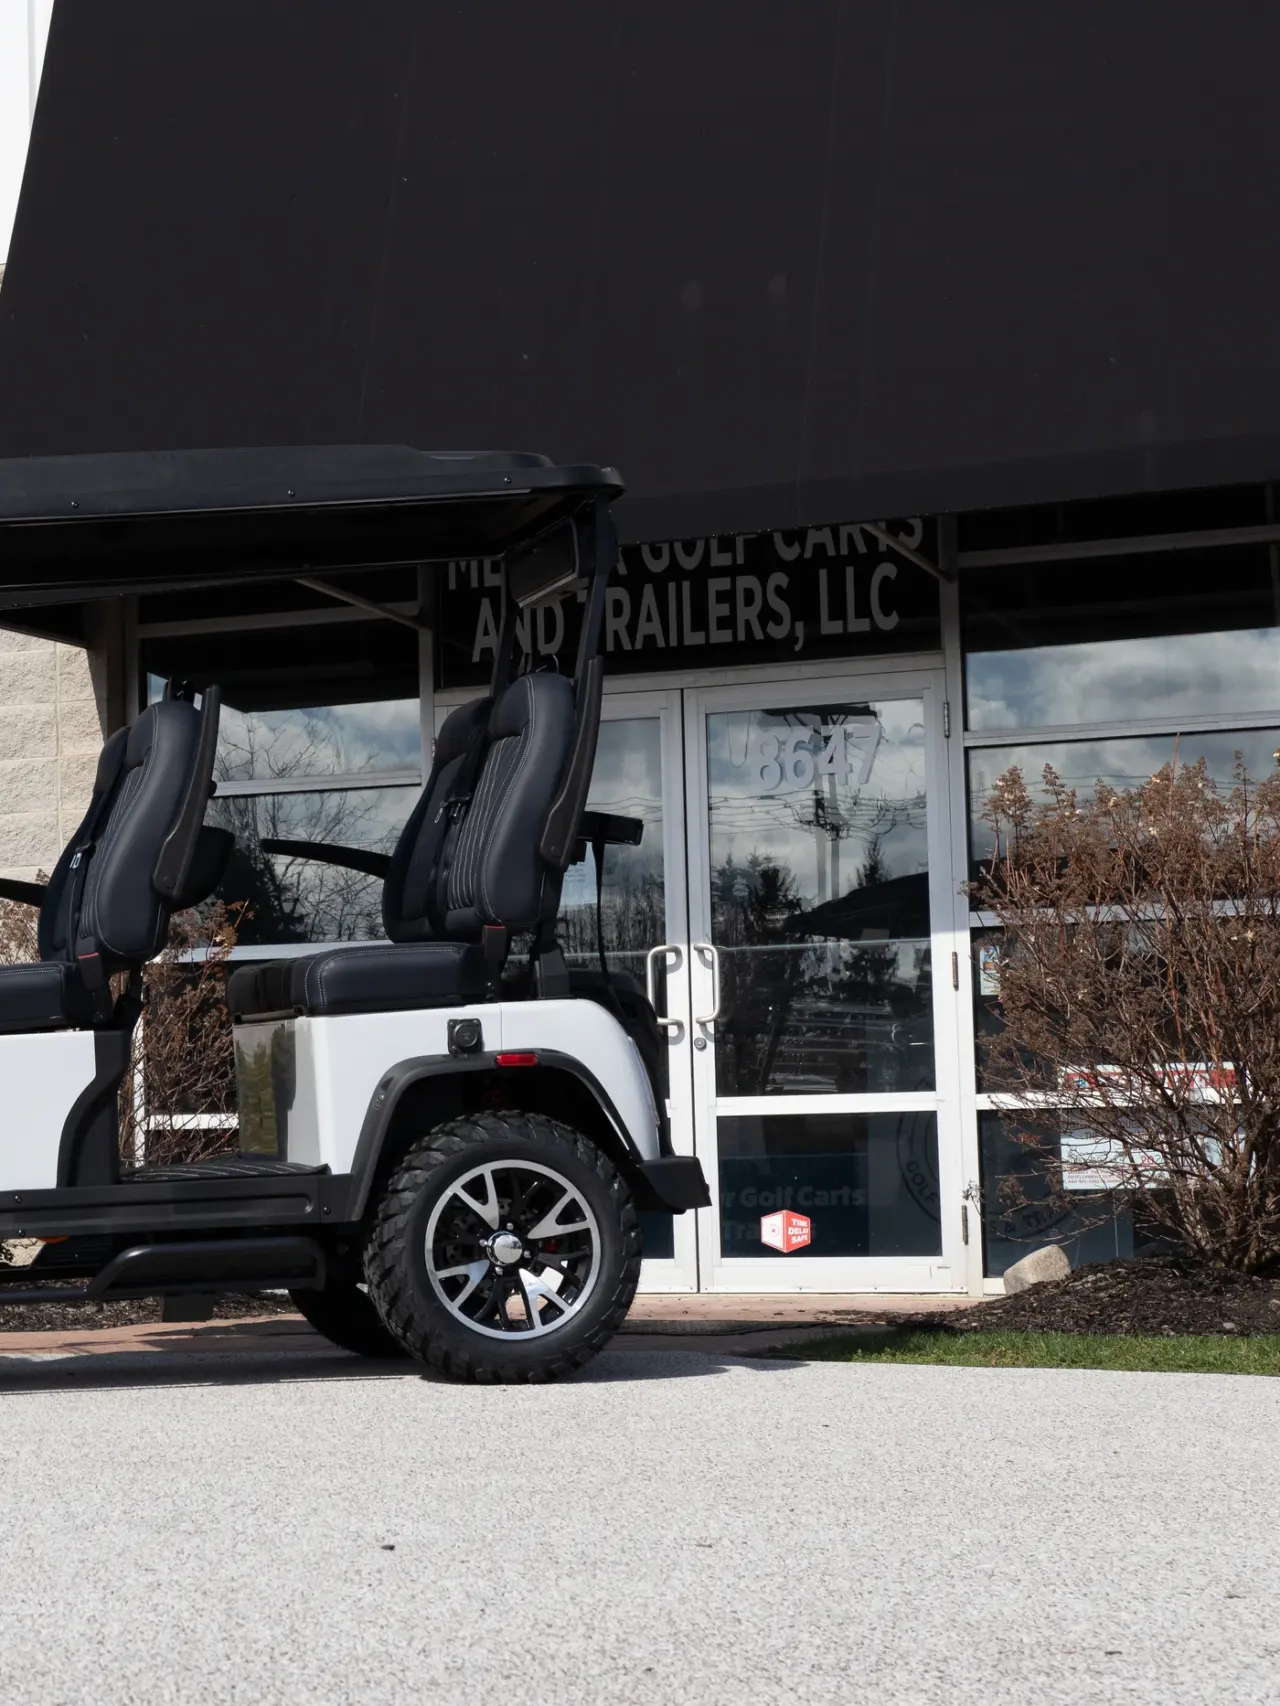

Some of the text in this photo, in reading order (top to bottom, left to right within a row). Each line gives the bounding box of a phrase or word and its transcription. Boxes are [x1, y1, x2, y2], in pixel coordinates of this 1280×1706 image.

[577, 572, 806, 652] RAILERS,
[820, 562, 901, 635] LLC
[757, 724, 884, 791] 8647
[739, 1185, 795, 1208] Golf
[796, 1184, 868, 1207] Carts
[791, 1218, 808, 1227] TIME
[788, 1227, 809, 1235] DELAY
[791, 1235, 808, 1244] SAFE
